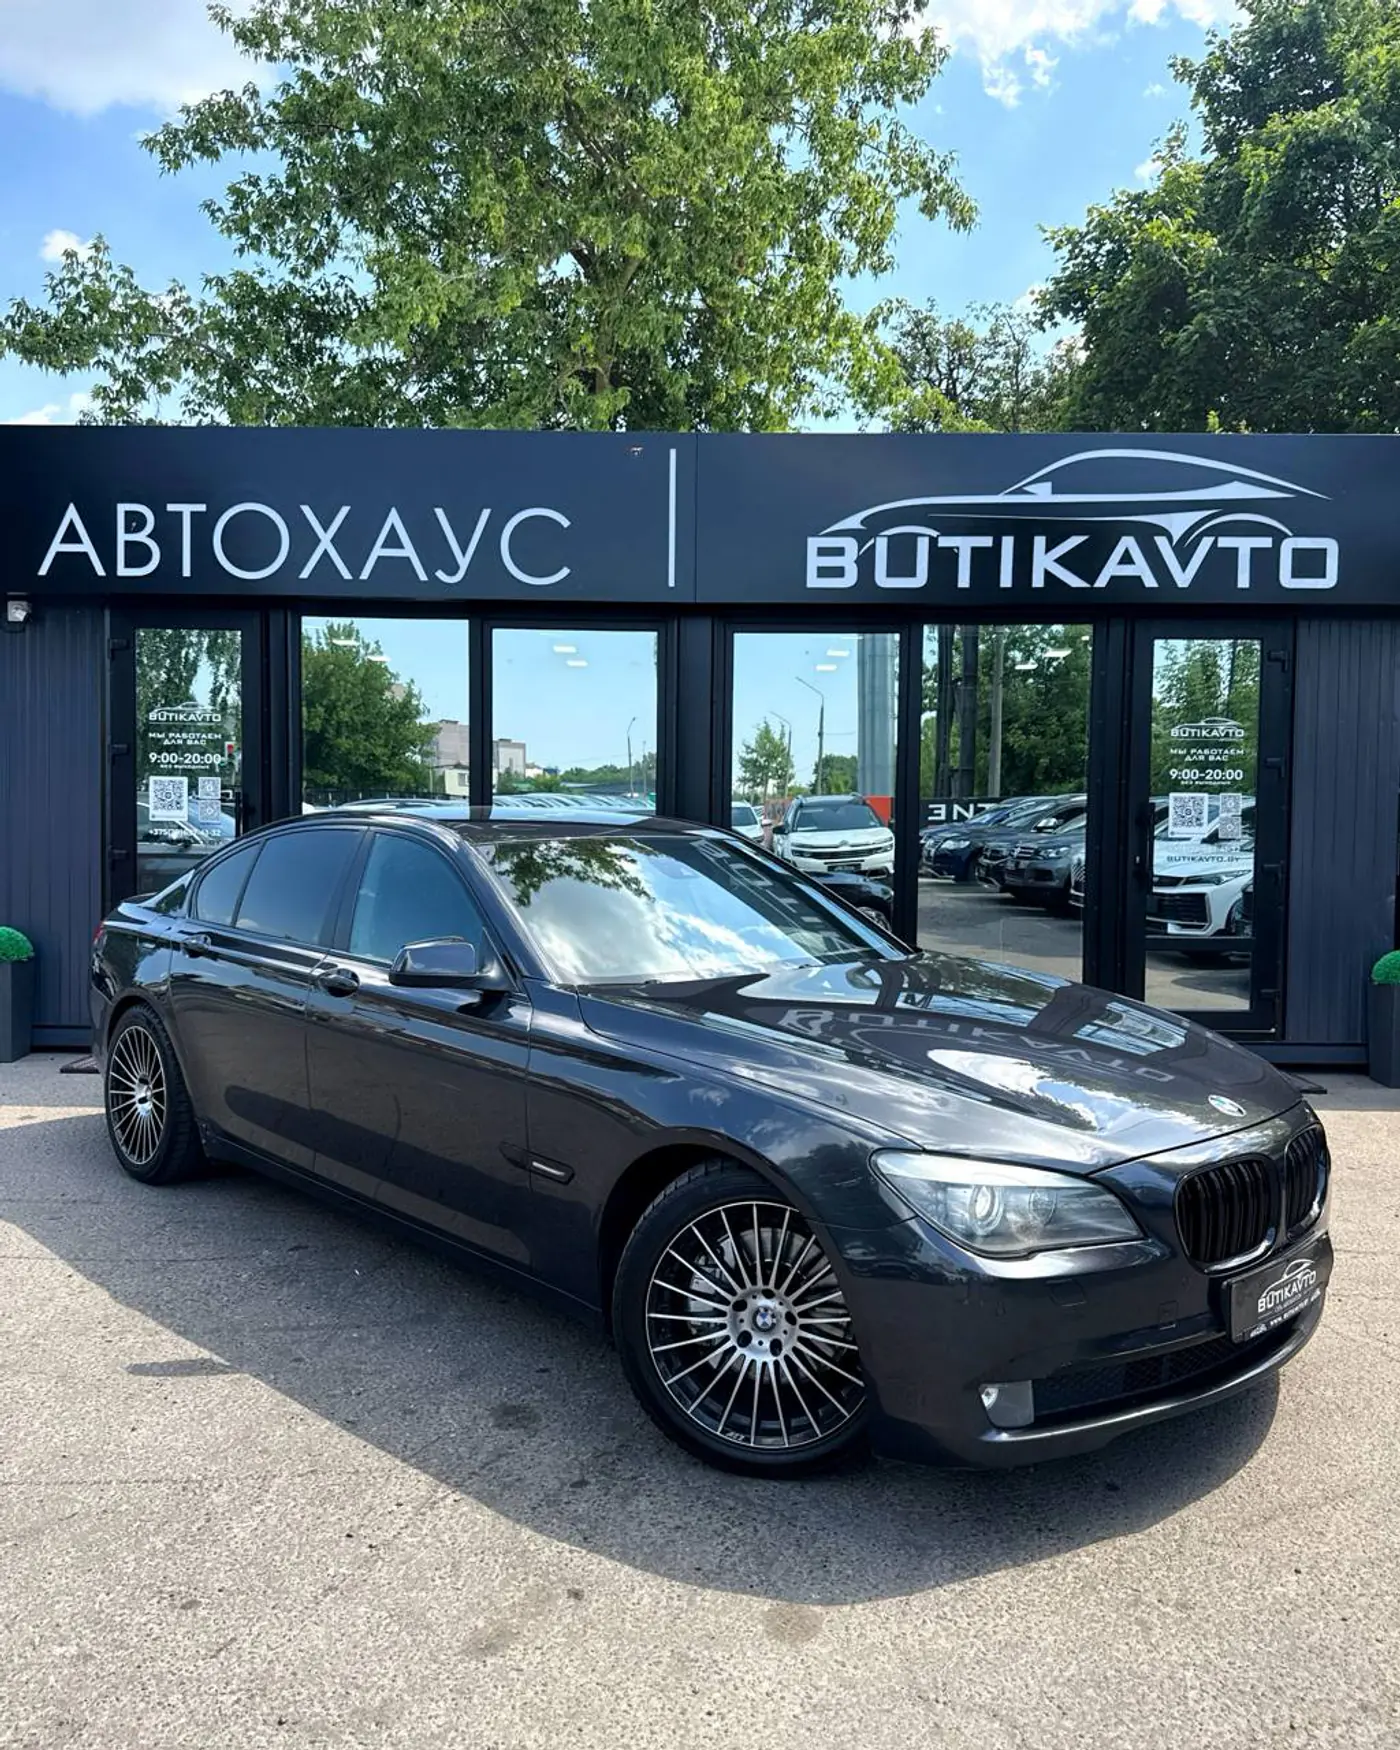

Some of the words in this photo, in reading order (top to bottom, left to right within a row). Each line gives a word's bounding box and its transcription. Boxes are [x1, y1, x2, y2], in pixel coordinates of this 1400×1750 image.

[38, 503, 571, 585] АВТОХАУС
[806, 536, 1338, 589] BUTIKAVTO
[149, 711, 222, 722] BUTIKAVTO
[1170, 728, 1244, 738] BUTIKAVTO
[149, 752, 222, 765] 9:00-20:00
[1169, 769, 1244, 780] 9:00-20:00
[1257, 1270, 1317, 1313] BUTIKAVTO
